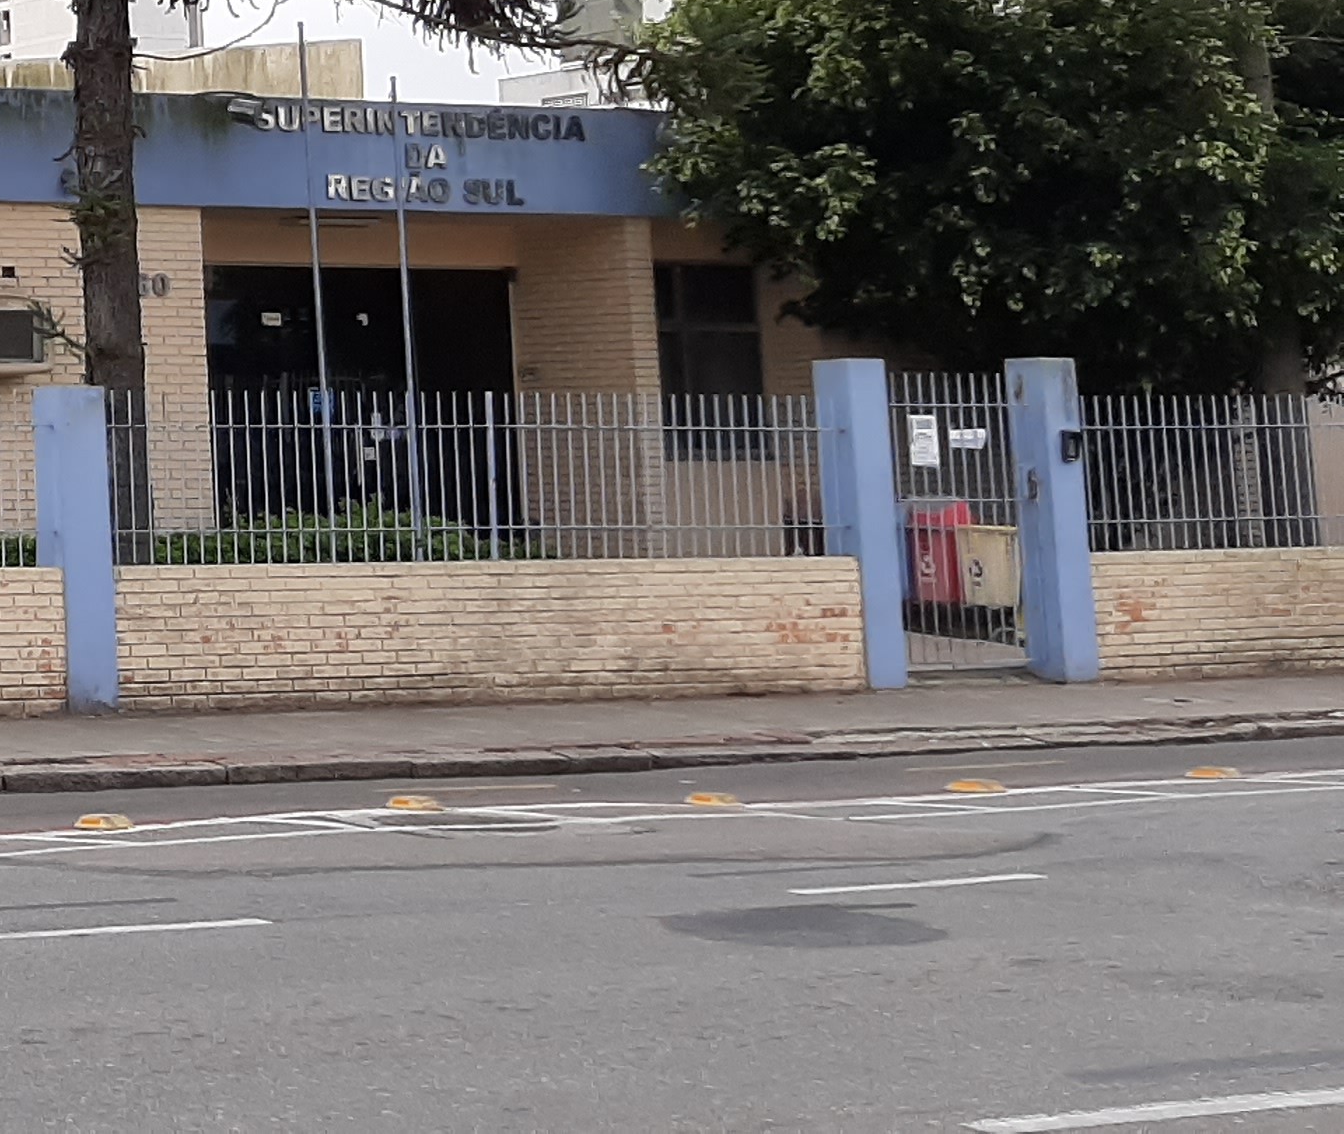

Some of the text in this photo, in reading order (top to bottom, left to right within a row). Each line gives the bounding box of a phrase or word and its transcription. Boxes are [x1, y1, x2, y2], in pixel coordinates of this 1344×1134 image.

[255, 104, 586, 142] SUPERINTENDÊNCIA
[405, 143, 447, 170] DA
[463, 179, 525, 206] SUL
